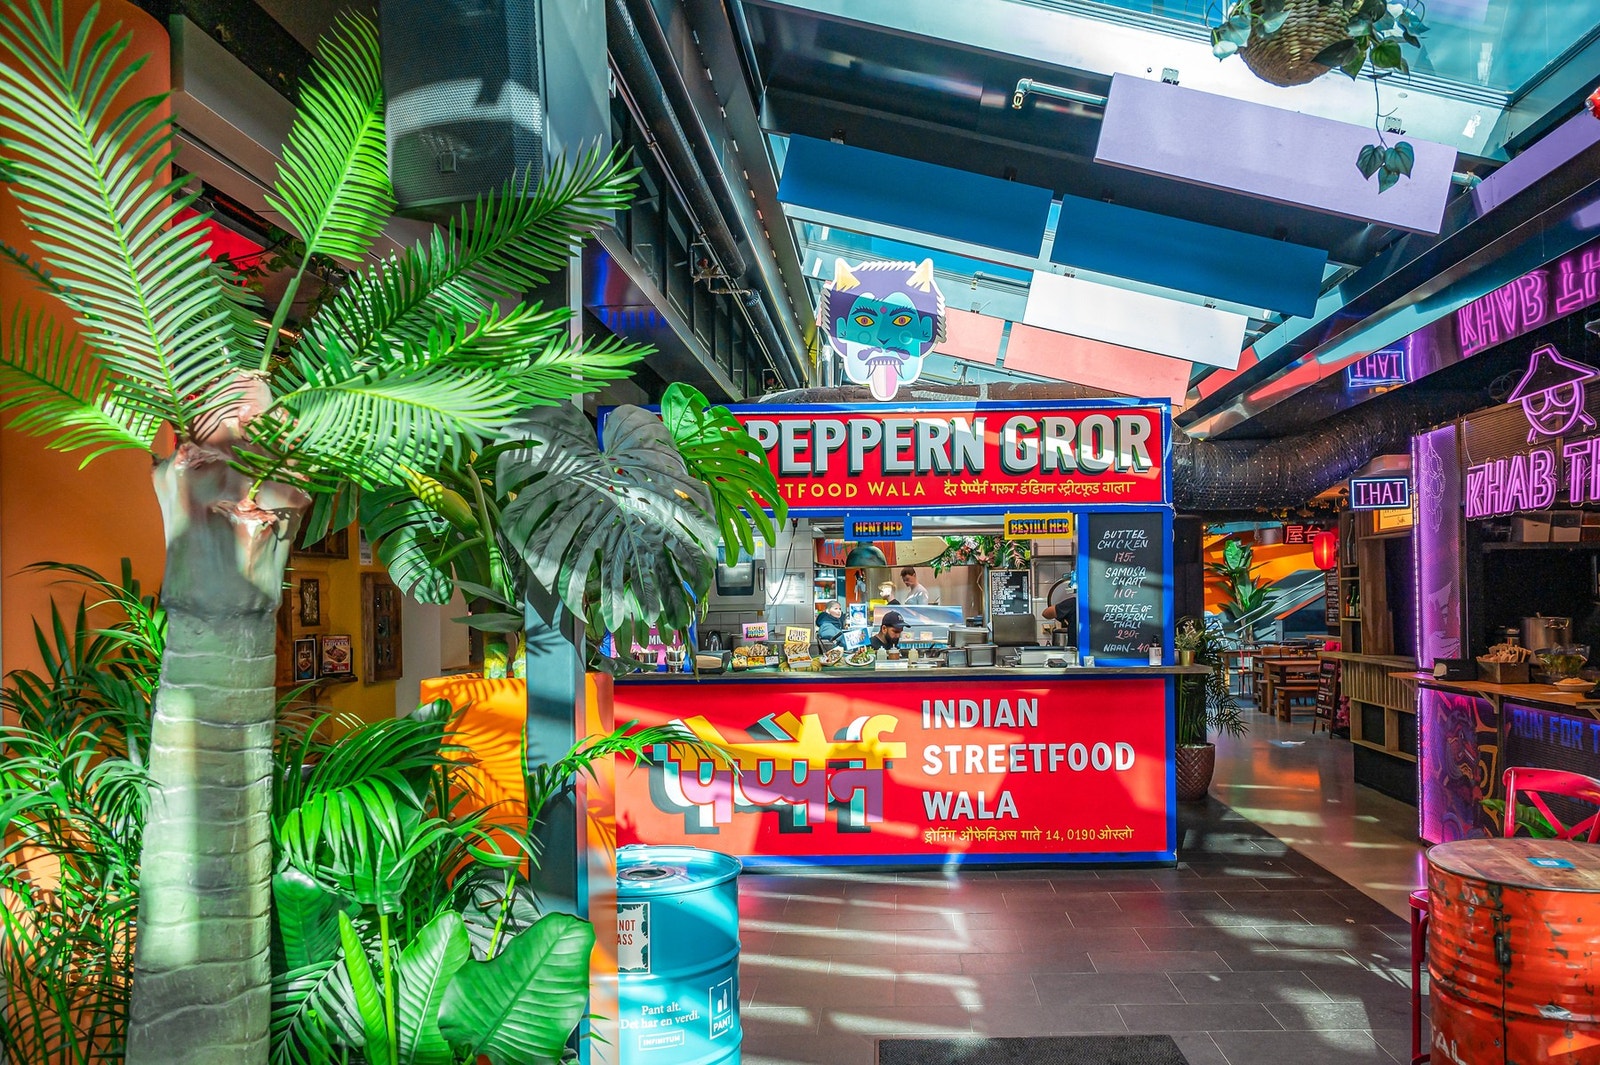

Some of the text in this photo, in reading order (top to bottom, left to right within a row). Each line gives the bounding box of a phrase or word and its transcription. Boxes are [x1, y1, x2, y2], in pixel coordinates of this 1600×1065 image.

[744, 414, 1153, 476] PEPPERN GROR
[867, 481, 926, 497] WALA
[1465, 449, 1556, 518] KHAB
[1355, 481, 1405, 505] THAI
[854, 522, 903, 536] HENT HER
[1009, 519, 1069, 534] BESTILL HER
[1103, 529, 1147, 540] BUTTER
[1097, 540, 1148, 550] CHICKEN
[1105, 566, 1146, 578] SAMOSA
[1112, 577, 1146, 588] CHAAT
[1104, 603, 1140, 613] TASTE
[1113, 620, 1141, 629] THALI
[921, 698, 1038, 729] INDIAN
[1513, 709, 1543, 741] RUN
[1550, 716, 1583, 750] FOR
[922, 742, 1135, 775] STREETFOOD
[922, 791, 1019, 820] WALA
[1046, 829, 1064, 841] 14,
[1067, 828, 1096, 840] 0190
[618, 919, 636, 931] NOT
[616, 933, 633, 945] ASS
[641, 1001, 681, 1016] Pant alt.
[620, 1010, 700, 1029] Det har en verdi.
[713, 1016, 731, 1032] PANT
[643, 1035, 681, 1046] INFINITUM
